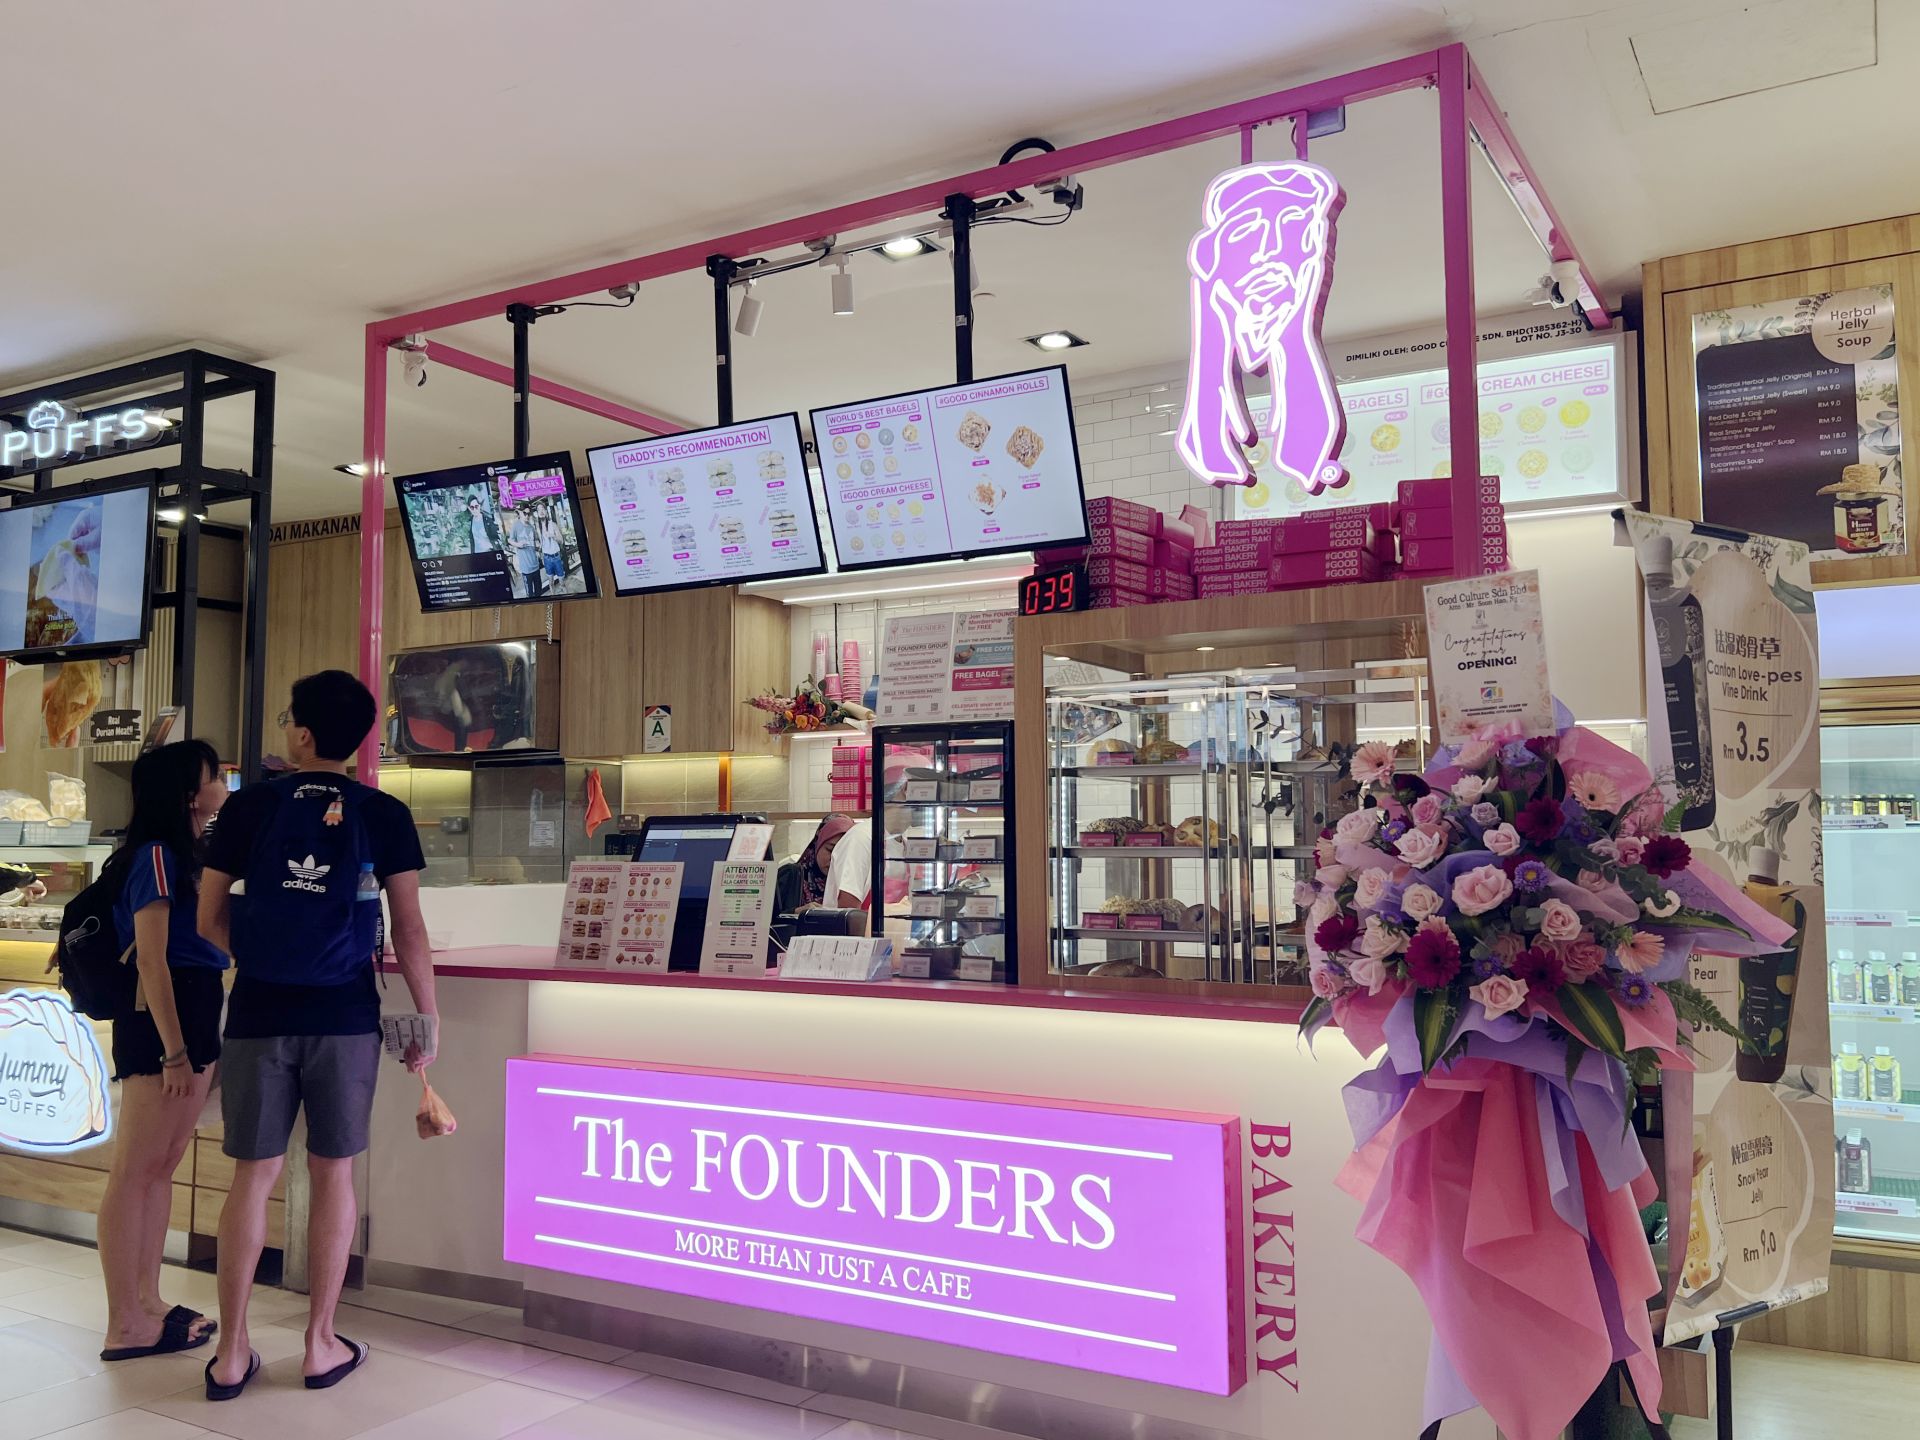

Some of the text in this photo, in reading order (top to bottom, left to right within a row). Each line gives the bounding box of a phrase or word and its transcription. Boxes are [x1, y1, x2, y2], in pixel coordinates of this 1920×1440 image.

[1830, 305, 1876, 321] Herbal
[1838, 317, 1868, 331] Jelly
[1515, 326, 1582, 343] LOT NO. J3-30
[1837, 335, 1872, 348] Soup
[1346, 350, 1381, 362] DIMILIKI
[1382, 346, 1409, 357] OLEH:
[1410, 342, 1437, 353] GOOD
[1482, 331, 1504, 341] SDN.
[1482, 365, 1604, 392] CREAM CHEESE
[1742, 376, 1764, 386] Herbal
[1829, 367, 1840, 375] 9.0
[939, 378, 1045, 406] #GOOD CINNAMON ROLLS
[1349, 393, 1404, 410] BAGELS
[829, 402, 917, 424] WORLD'S BEST BAGELS
[1708, 412, 1721, 421] Red
[1722, 411, 1740, 420] Date
[1724, 426, 1742, 436] Snow
[1830, 415, 1841, 423] 9.0
[2, 408, 148, 465] PUFFS
[617, 431, 767, 465] #DADDY'S RECOMMENDATION
[1745, 457, 1764, 467] Soup
[526, 479, 559, 491] FOUNDERS
[842, 481, 929, 500] #GOOD CREAM CHEESE
[1303, 505, 1371, 521] Artisan BAKERY
[289, 514, 361, 541] MAKANAN
[1219, 518, 1286, 530] Artisan BAKERY
[1330, 520, 1362, 530] #GOOD
[1330, 529, 1362, 539] #GOOD
[1194, 543, 1259, 556] Artisan BAKERY
[1330, 538, 1363, 547] #GOOD
[1194, 551, 1259, 565] Artisan BAKERY
[1325, 550, 1358, 560] #GOOD
[1194, 560, 1259, 573] Artisan BAKERY
[1325, 559, 1358, 569] #GOOD
[1201, 571, 1268, 583] Artisan BAKERY
[1325, 568, 1358, 577] #GOOD
[1201, 579, 1268, 591] Artisan BAKERY
[1025, 573, 1074, 615] 039
[1437, 595, 1457, 606] Good
[1459, 591, 1490, 603] Culture
[1492, 587, 1508, 597] Sdn
[1444, 628, 1527, 652] Congratulations
[1457, 656, 1518, 671] OPENING!
[955, 670, 1000, 679] FREE BAGEL
[1706, 660, 1803, 686] Canton Love-pes
[1722, 682, 1768, 702] Vine Drink
[652, 721, 664, 736] A
[1723, 721, 1770, 762] Rm 3.5
[725, 866, 765, 874] ATTENTION
[282, 879, 327, 893] adidas
[1694, 967, 1718, 981] Pear
[573, 1115, 1117, 1253] The FOUNDERS
[1737, 1173, 1756, 1188] Snow
[1743, 1229, 1777, 1262] Rm 9.0
[1249, 1118, 1300, 1394] BAKERY
[674, 1229, 973, 1302] MORE THAN JUST A CAFE
